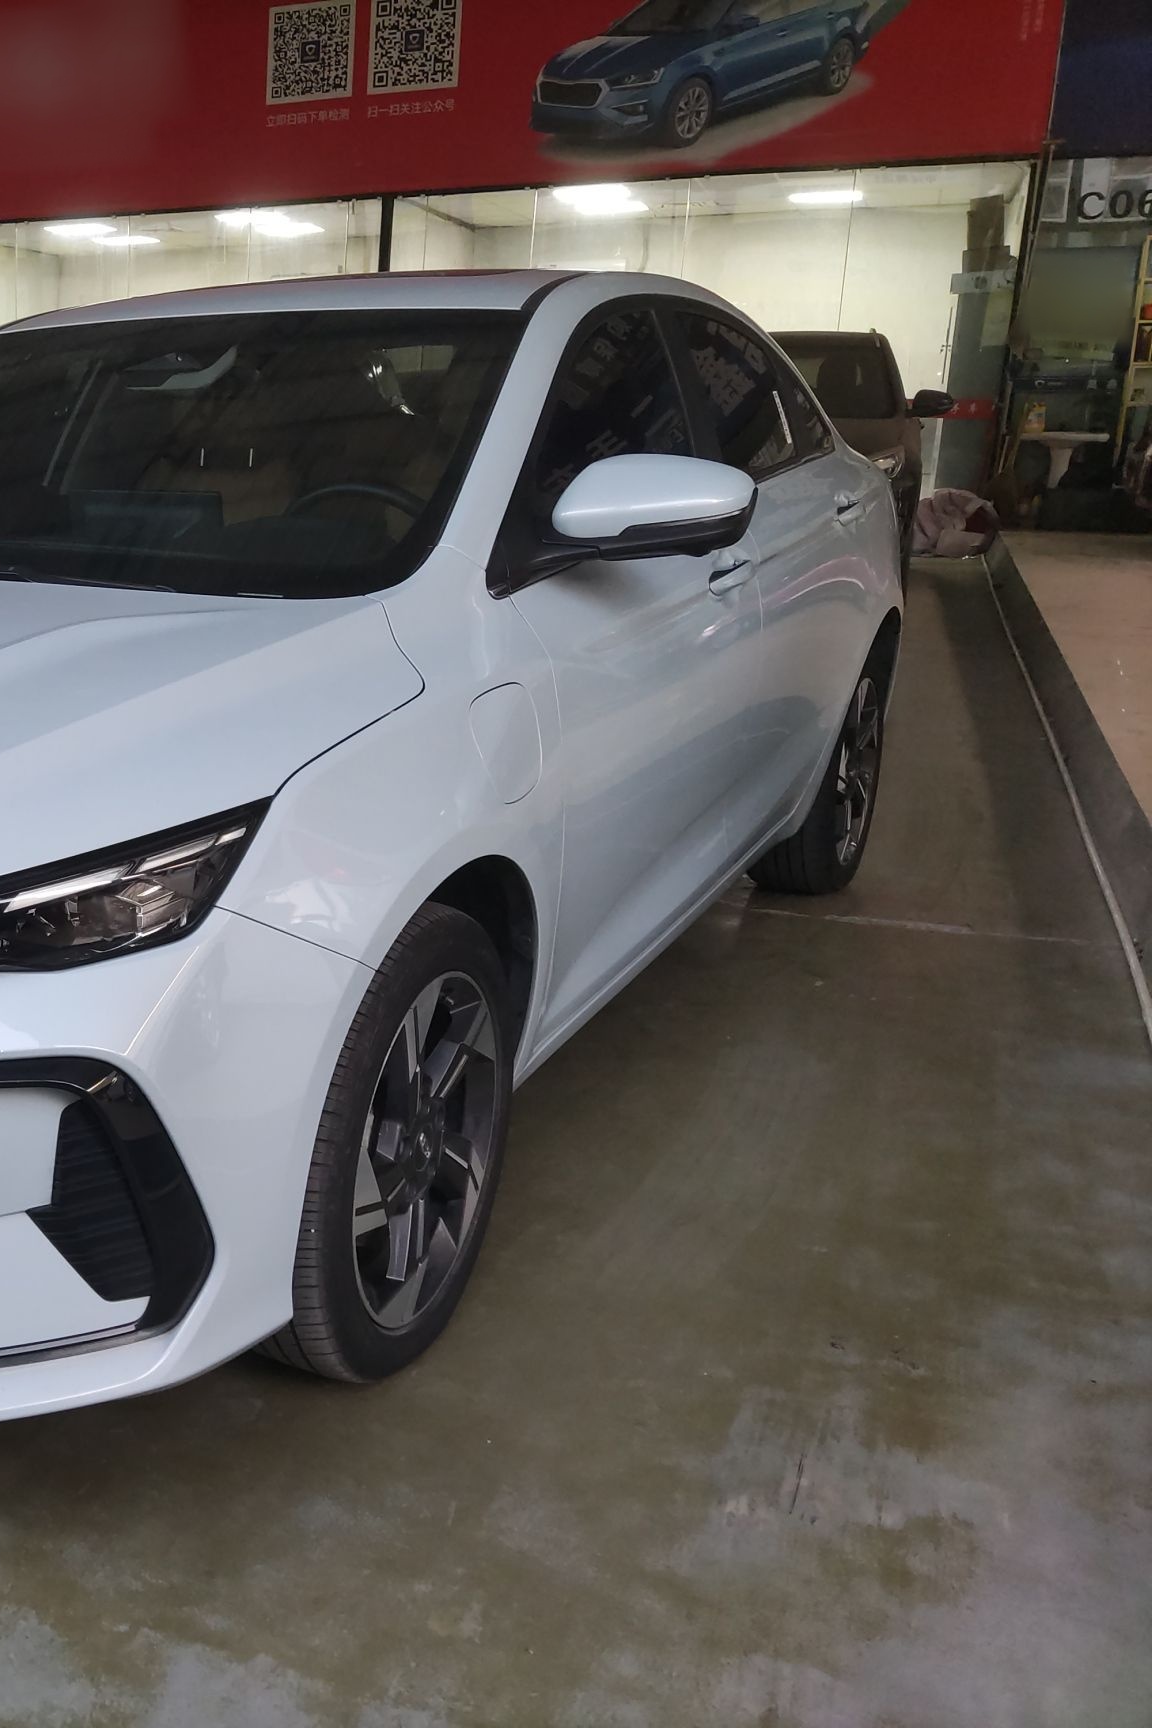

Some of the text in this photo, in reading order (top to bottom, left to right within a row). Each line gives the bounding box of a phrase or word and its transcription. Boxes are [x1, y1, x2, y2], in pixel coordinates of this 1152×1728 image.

[265, 108, 350, 127] 立即扫码下单检测
[367, 98, 455, 118] 扫一扫关注公众号
